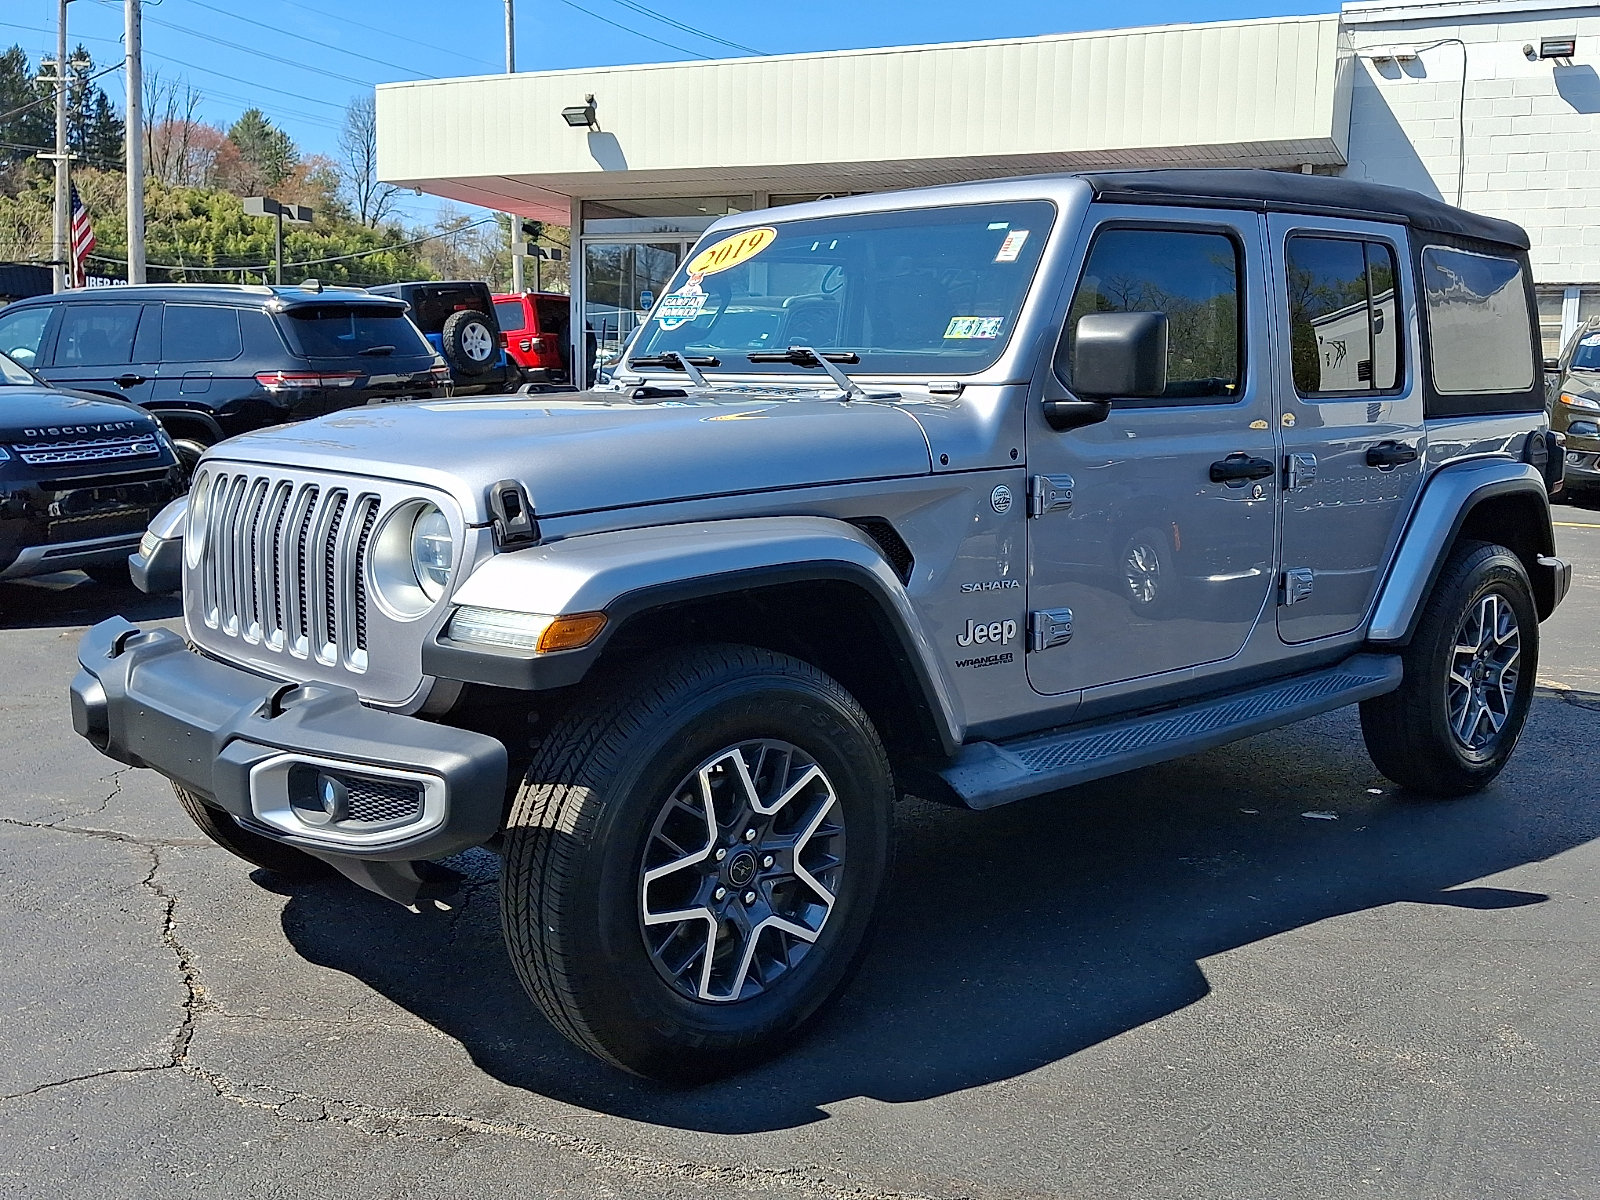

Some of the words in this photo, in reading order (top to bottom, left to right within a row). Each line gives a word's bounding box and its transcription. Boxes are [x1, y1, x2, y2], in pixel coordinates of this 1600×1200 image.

[698, 231, 765, 272] 2019
[24, 421, 136, 438] DISCOVERY
[960, 579, 1021, 594] SAHARA
[956, 618, 1017, 647] Jeep
[955, 652, 1014, 668] WRANGLER
[973, 659, 1014, 668] UNLIMITED
